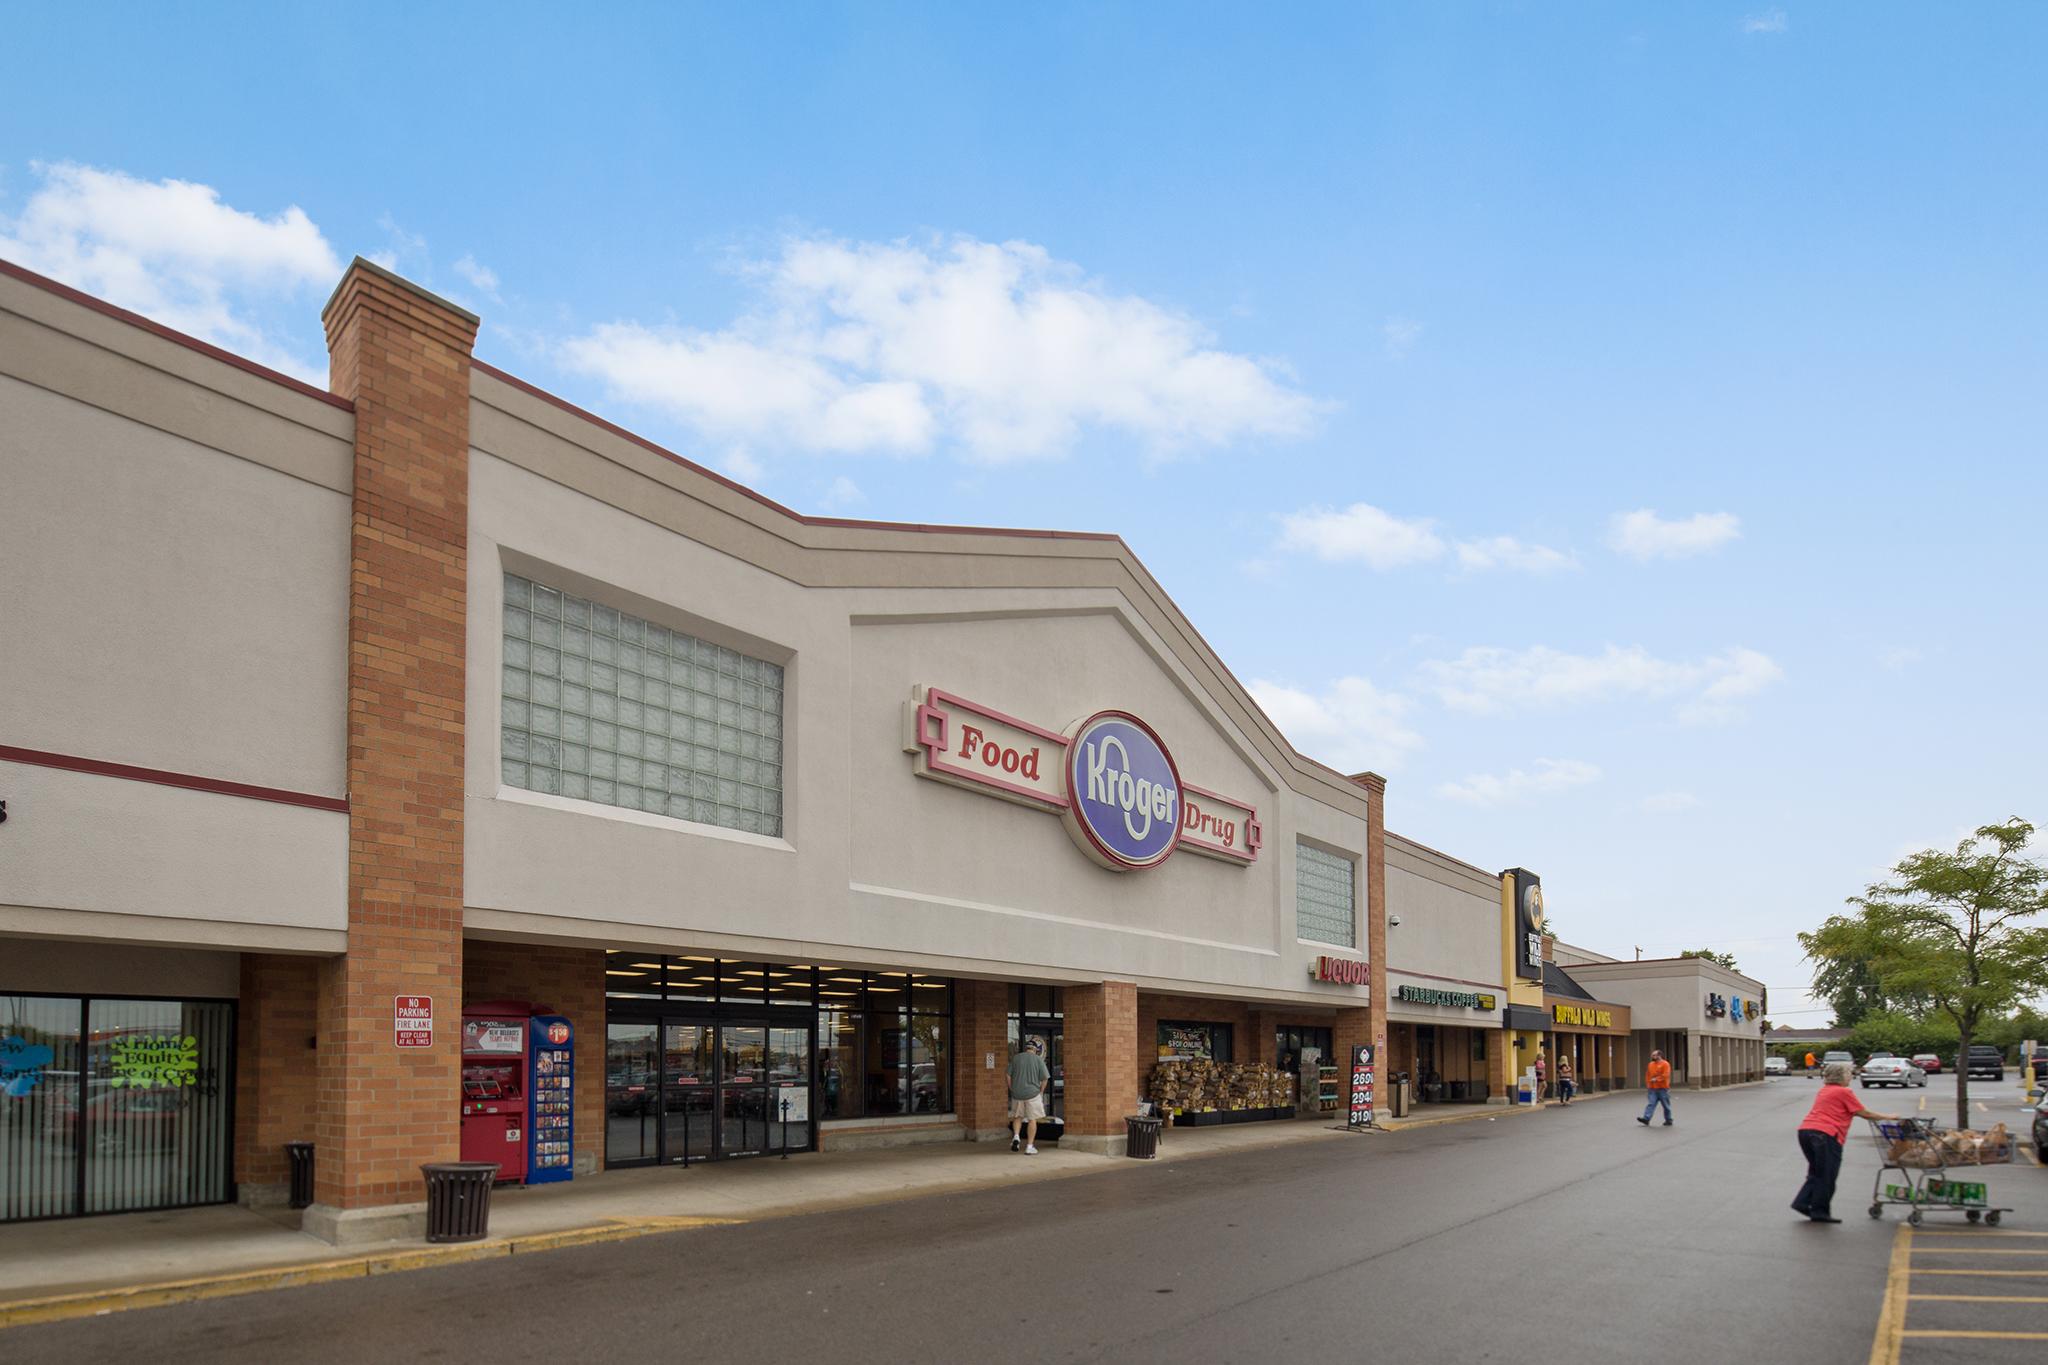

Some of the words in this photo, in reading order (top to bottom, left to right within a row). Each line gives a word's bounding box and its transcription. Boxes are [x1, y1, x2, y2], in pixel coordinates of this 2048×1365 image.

[958, 724, 1040, 781] Food
[1086, 735, 1176, 841] Kroger
[1184, 801, 1235, 847] Drug
[1319, 956, 1369, 985] LIQUOR
[408, 998, 419, 1008] NO
[1402, 985, 1451, 1006] STARBUCKS
[1452, 992, 1479, 1009] COFFEE
[398, 1007, 430, 1018] PARKING
[397, 1020, 412, 1029] FIRE
[413, 1020, 431, 1029] LANE
[400, 1031, 412, 1039] KEEP
[413, 1031, 428, 1039] CLEAR
[125, 1051, 185, 1065] Equity
[141, 1066, 162, 1082] of
